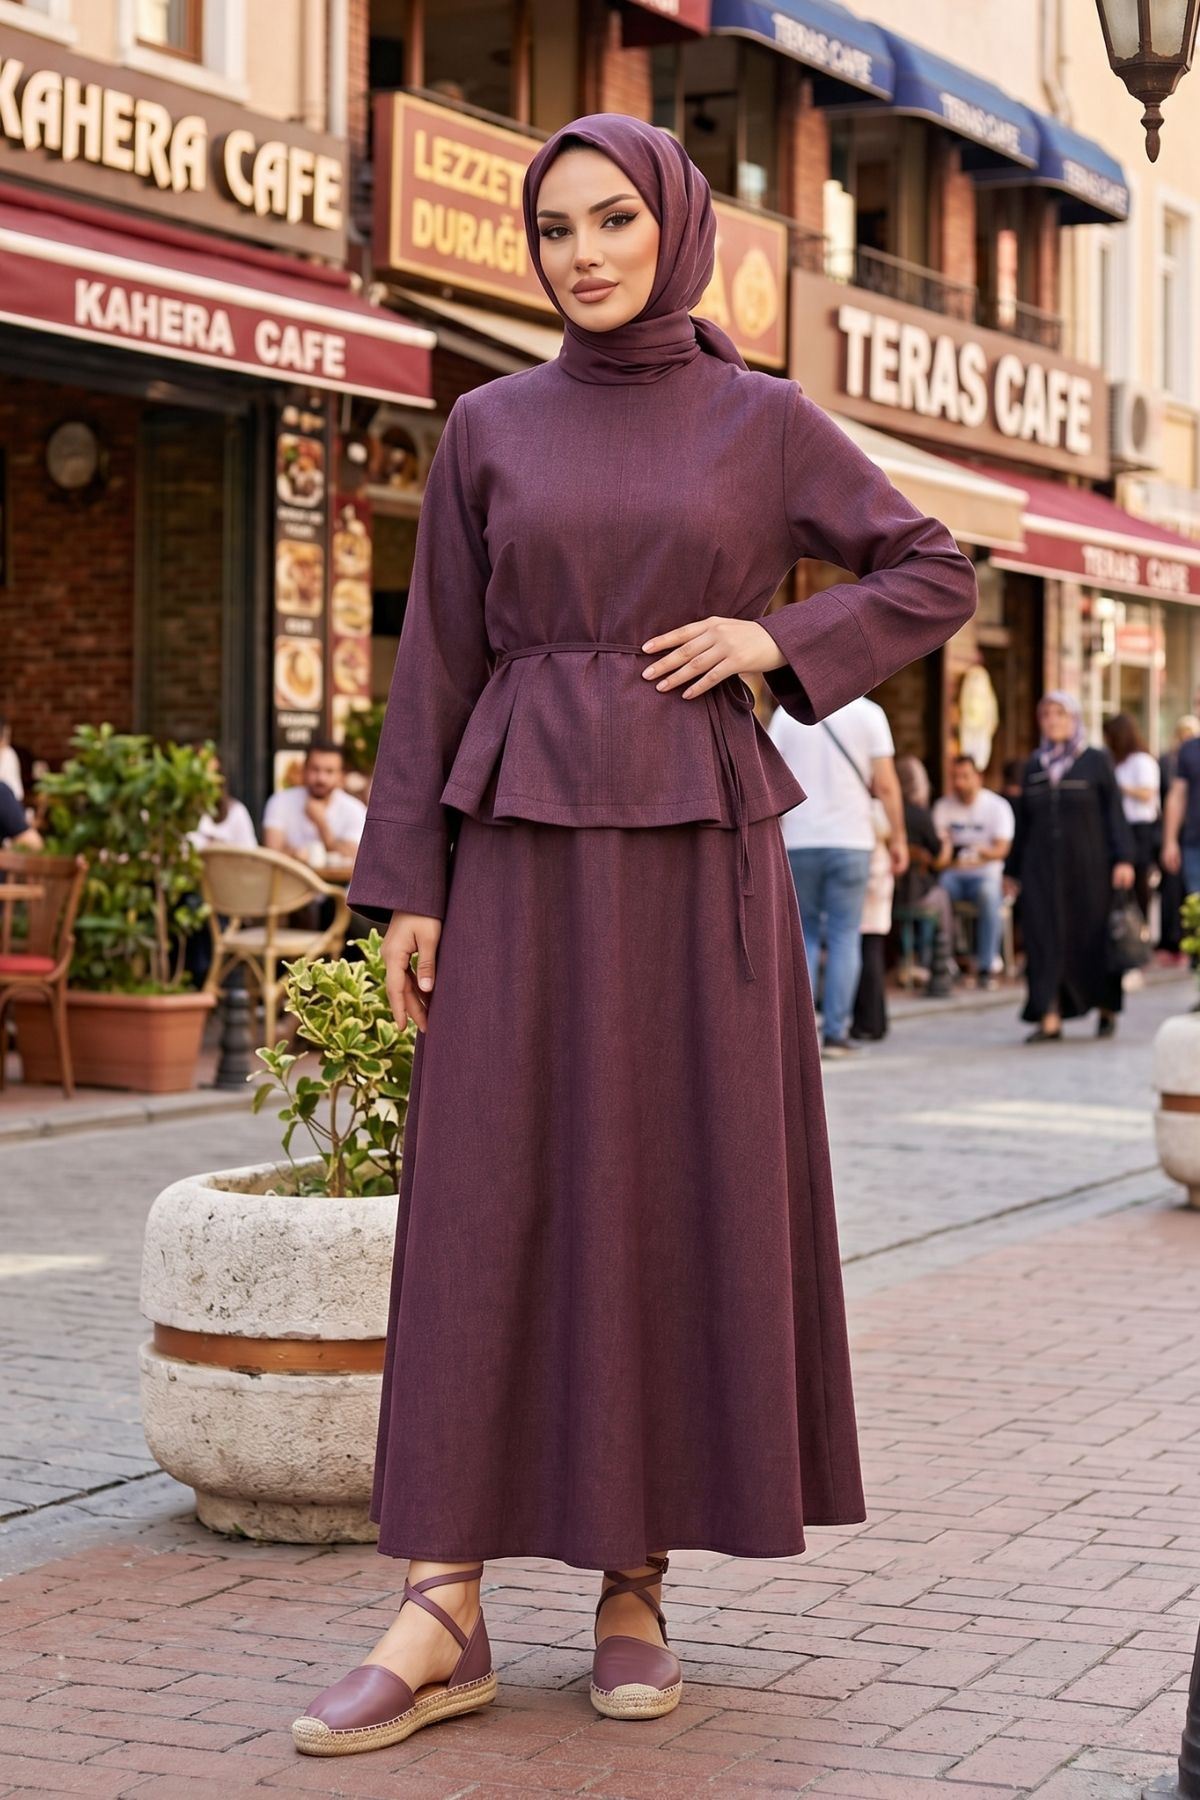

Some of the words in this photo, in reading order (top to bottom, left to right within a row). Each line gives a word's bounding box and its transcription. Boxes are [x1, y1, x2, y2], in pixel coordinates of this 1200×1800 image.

[0, 57, 208, 193] KAHERA
[224, 129, 343, 231] CAFE
[414, 129, 528, 210] LEZZET
[411, 197, 528, 277] DURAĞI
[74, 279, 235, 356] KAHERA
[254, 321, 346, 378] CAFE
[838, 304, 988, 428] TERAS
[994, 353, 1093, 455] CAFE
[1146, 557, 1190, 594] CAFE
